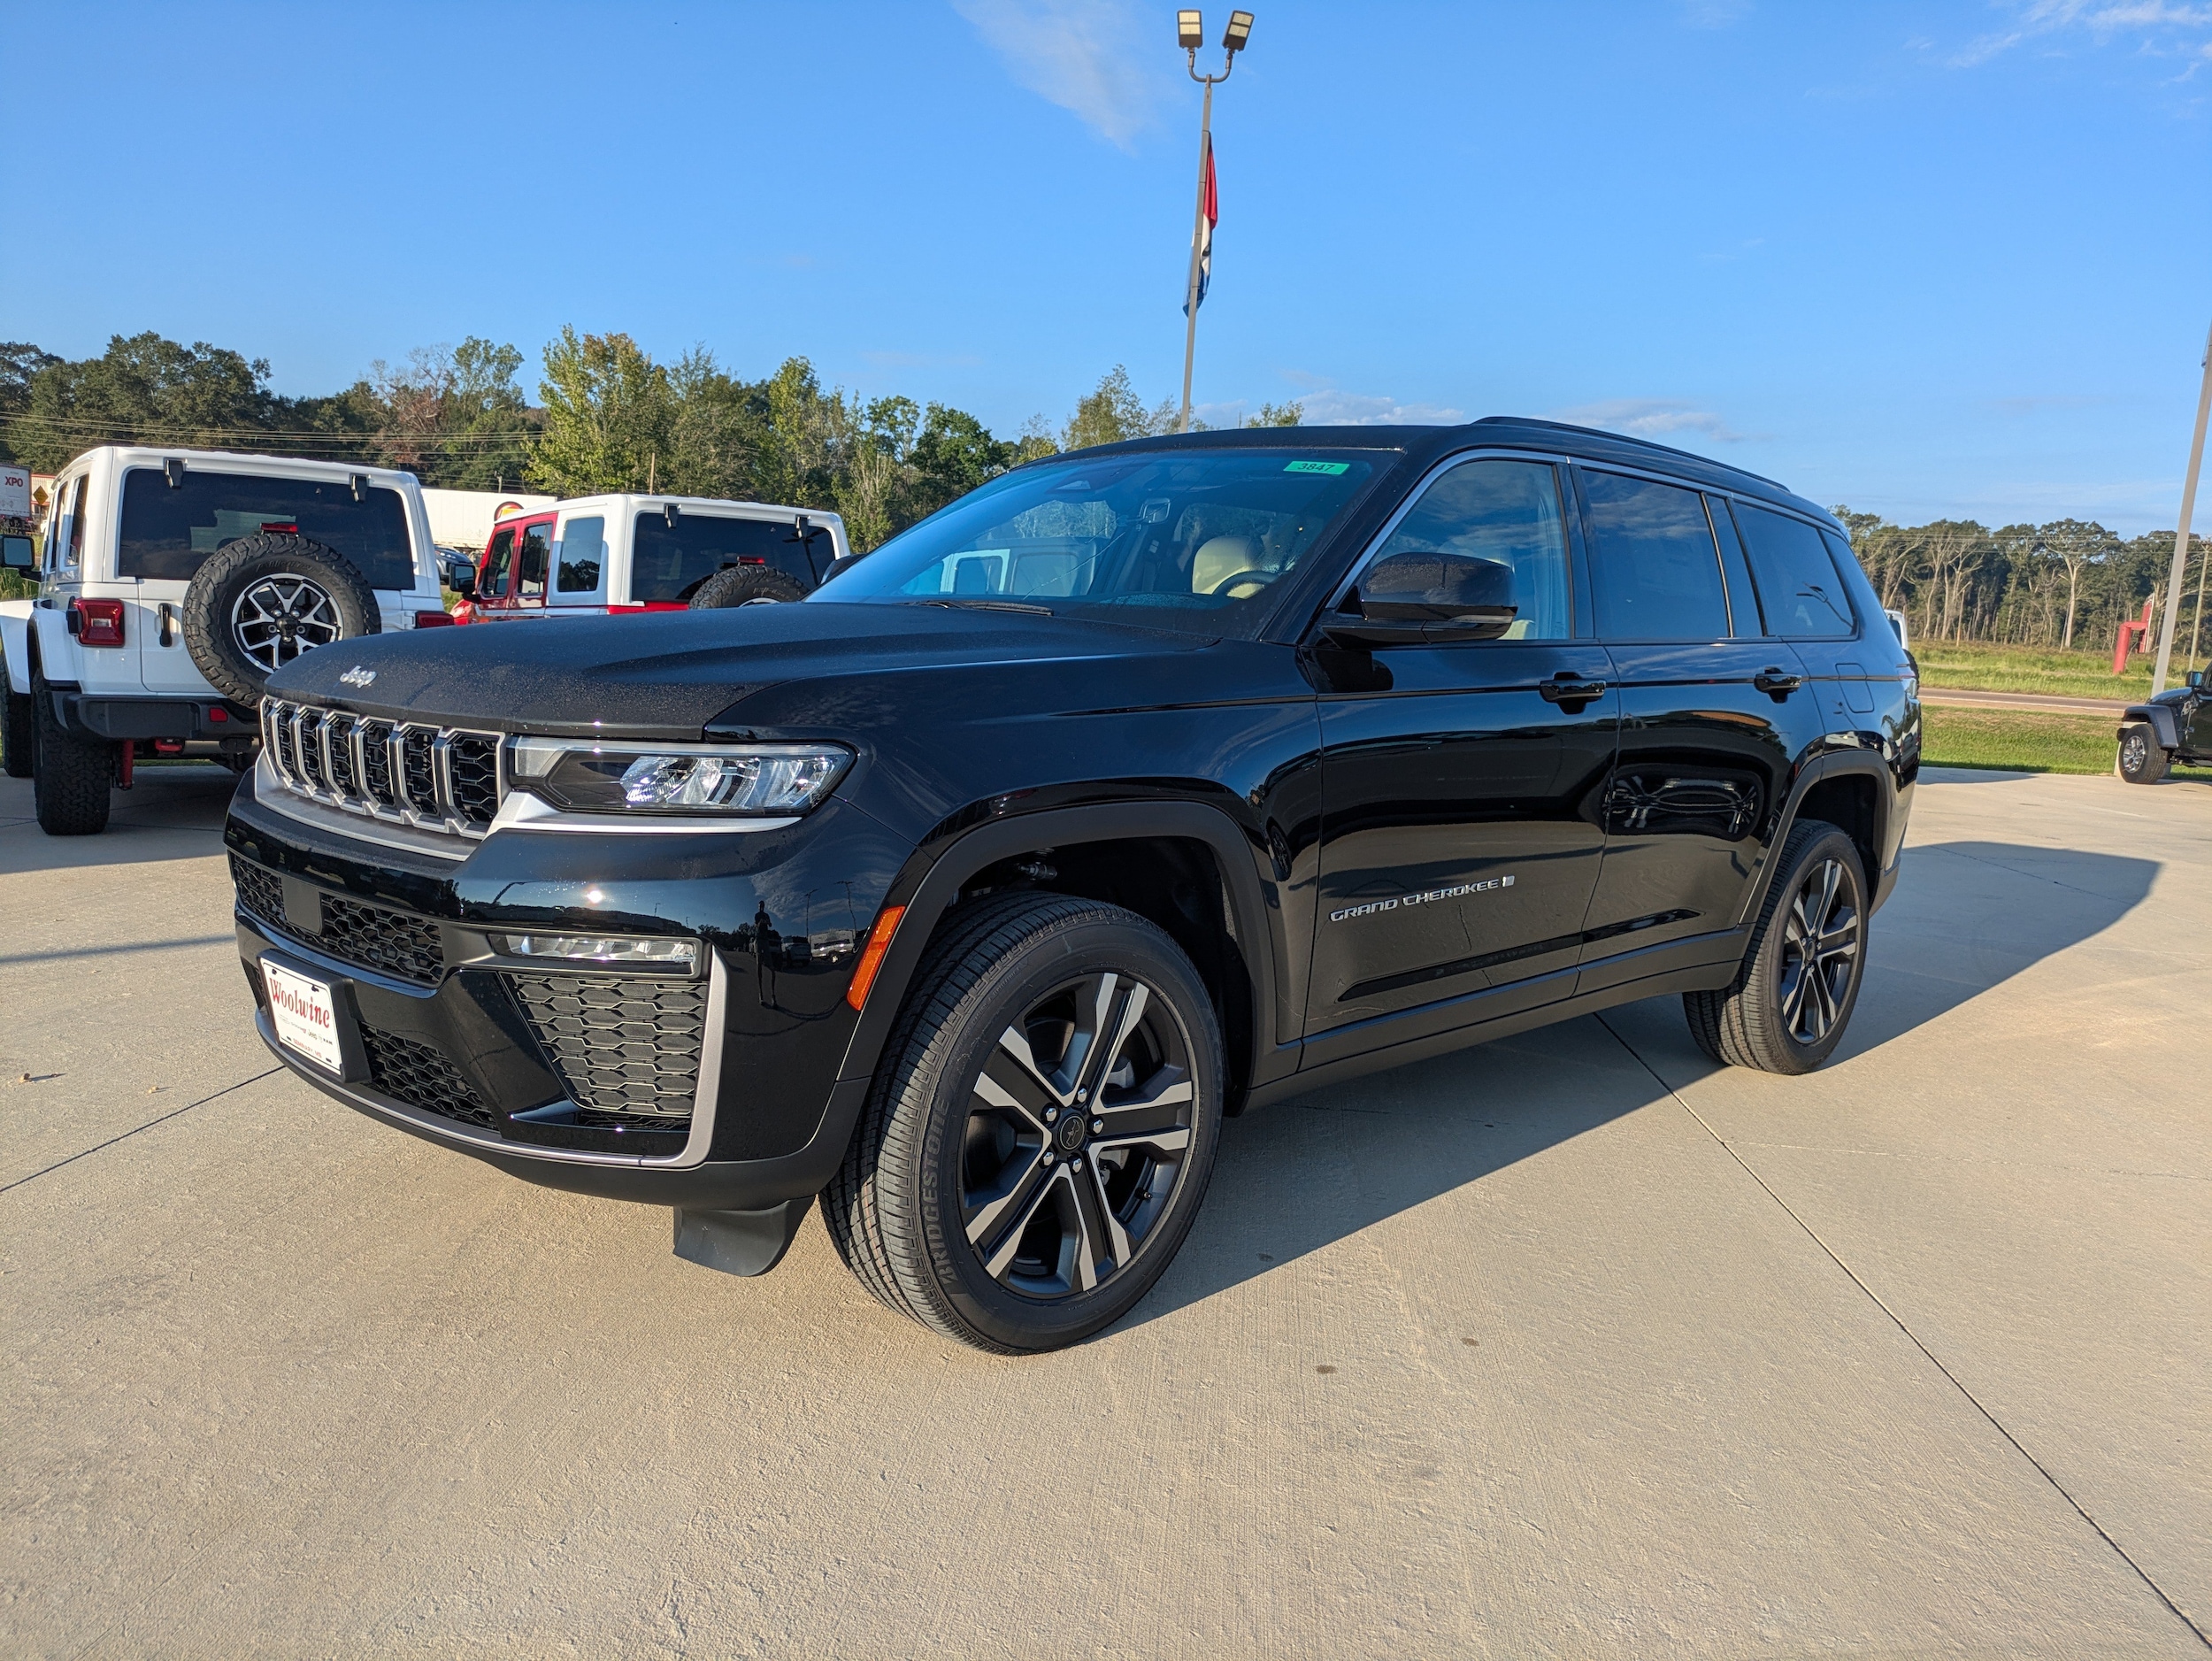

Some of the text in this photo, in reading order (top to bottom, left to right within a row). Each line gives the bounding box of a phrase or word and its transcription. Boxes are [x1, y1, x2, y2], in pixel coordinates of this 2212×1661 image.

[4, 476, 23, 487] XPO
[1298, 463, 1335, 472] 3847
[340, 665, 378, 689] Jeep
[1330, 898, 1398, 922] GRAND
[1402, 879, 1500, 906] CHEROKEE
[269, 977, 330, 1028] Woolwine
[922, 1097, 959, 1284] BRIDGESTONE
